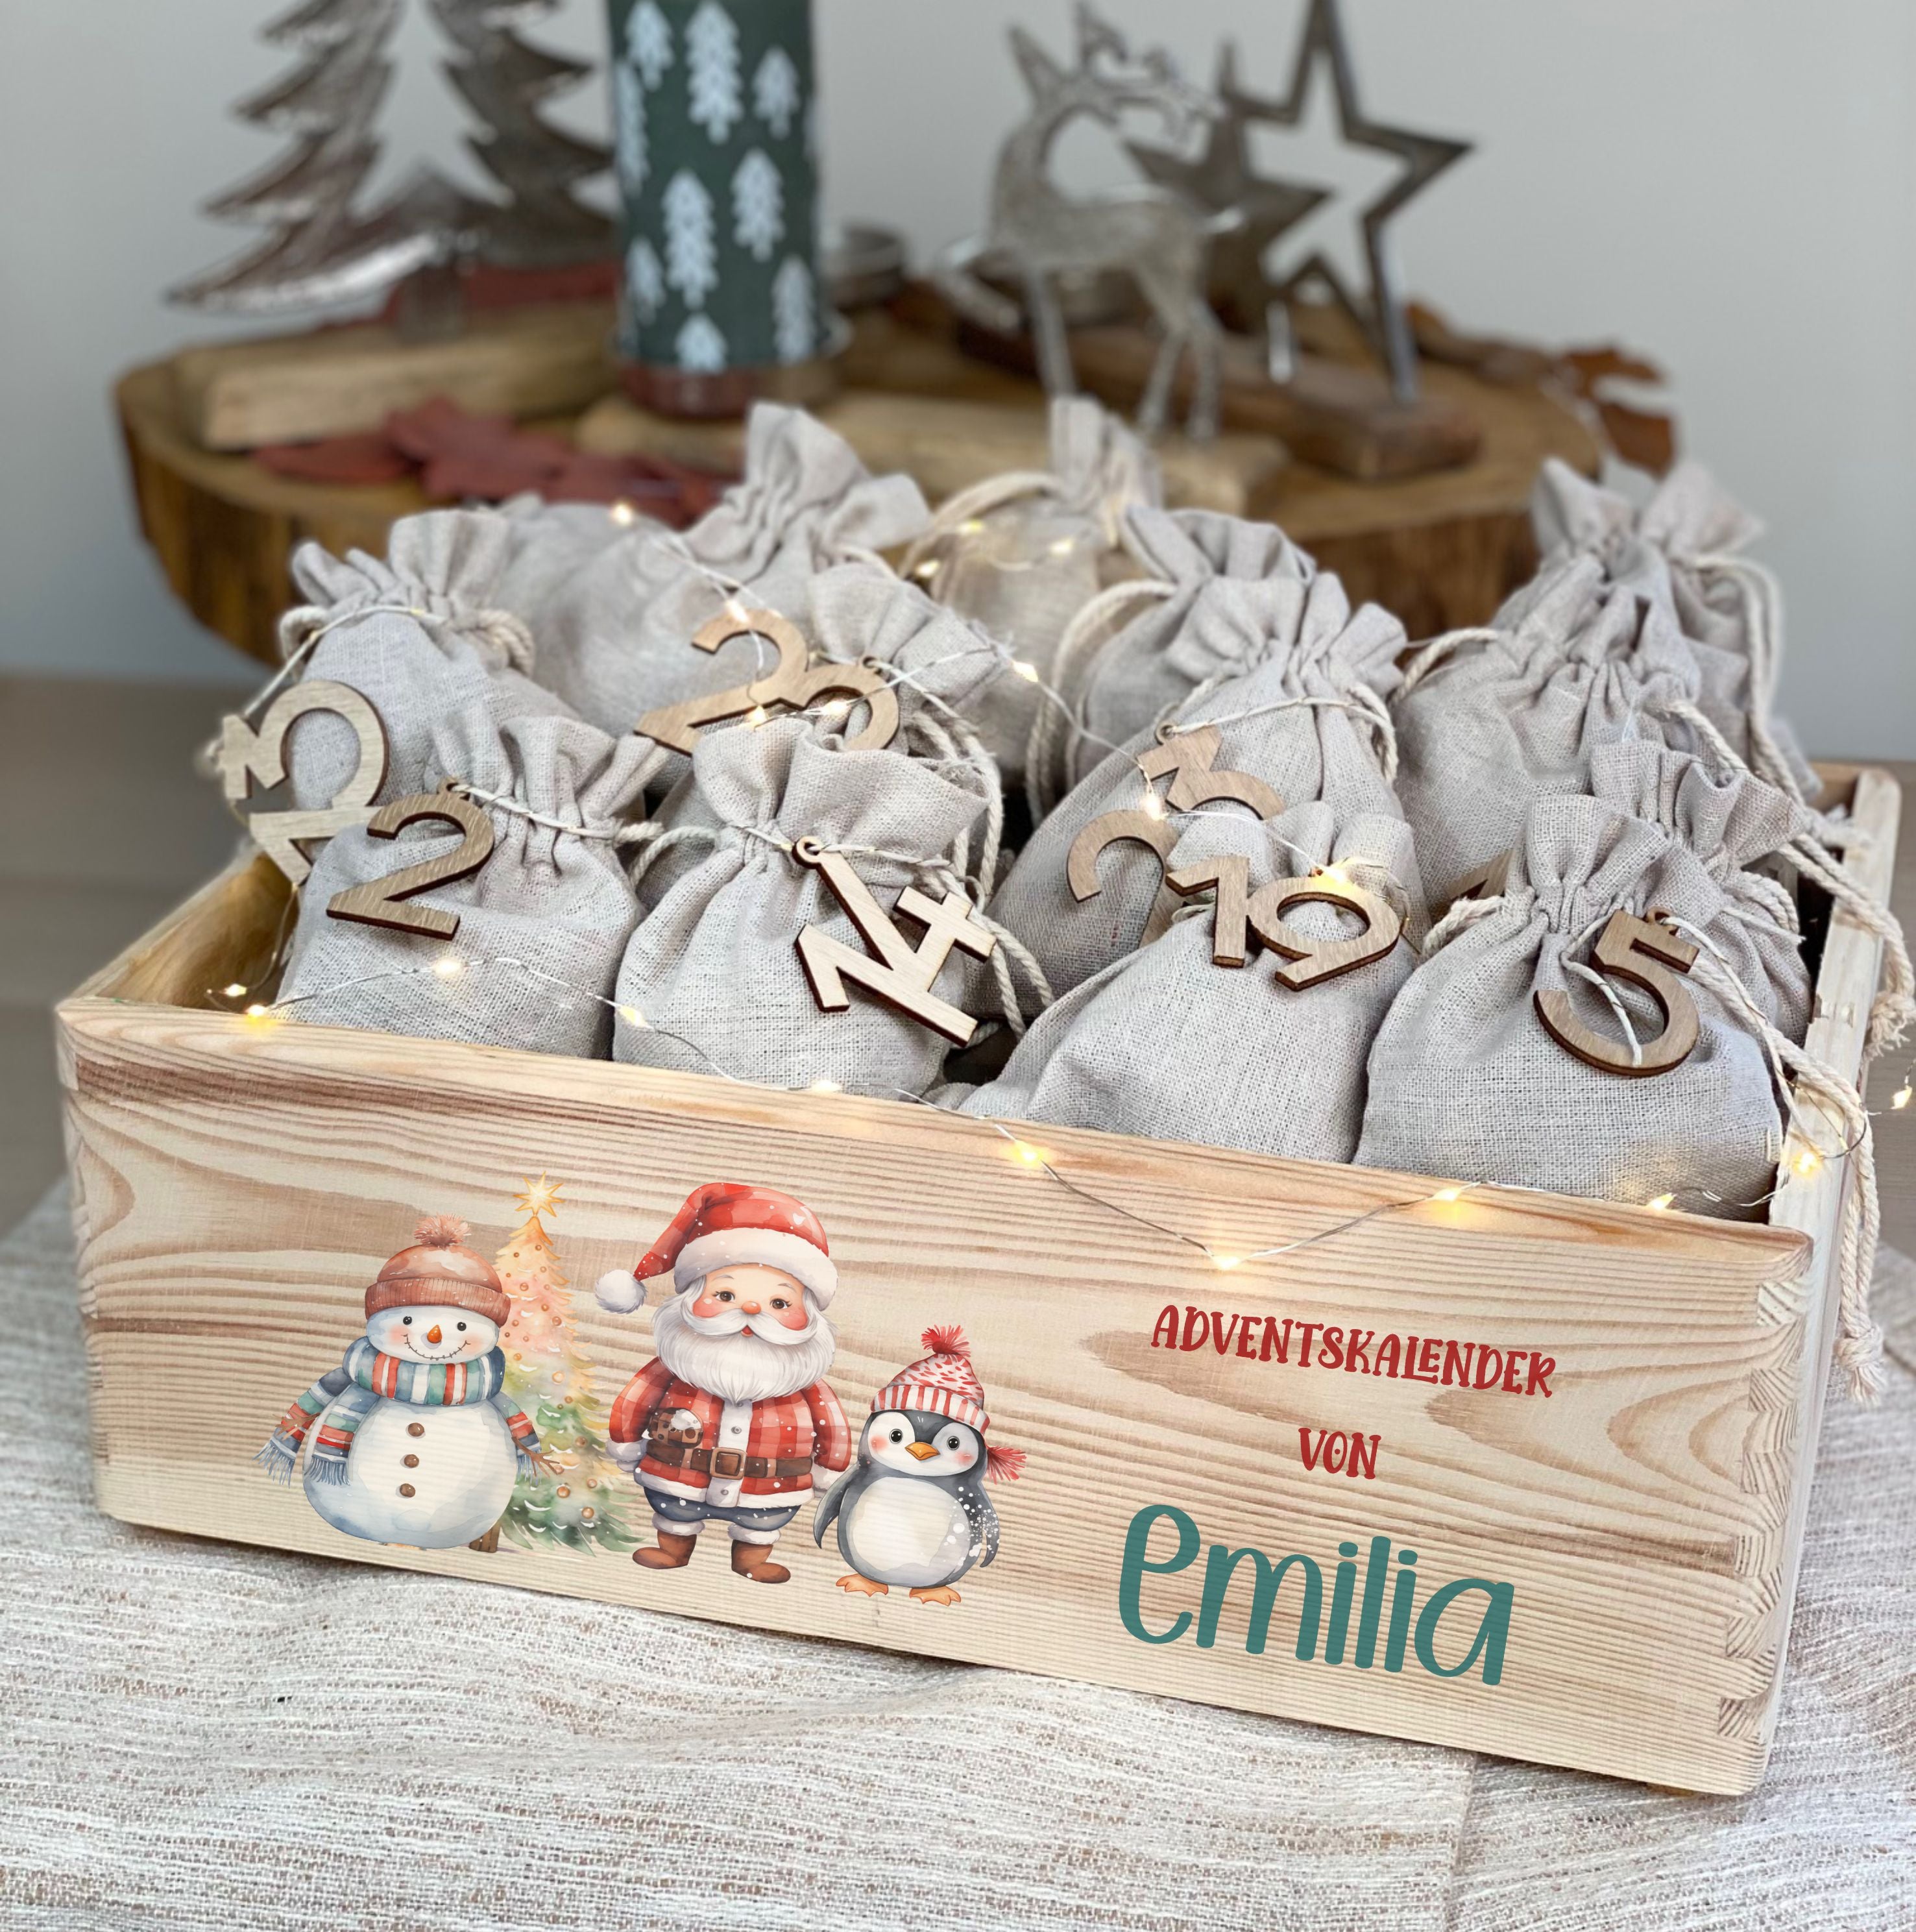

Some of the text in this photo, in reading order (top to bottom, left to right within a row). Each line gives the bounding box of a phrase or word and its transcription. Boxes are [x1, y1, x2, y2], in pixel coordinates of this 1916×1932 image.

[326, 792, 495, 941] 2
[1166, 855, 1400, 992] 19
[794, 844, 997, 1047] 14
[1533, 909, 1700, 1078] 5
[1151, 1305, 1556, 1397] ADVENTSKALENDER
[1298, 1427, 1381, 1480] VON
